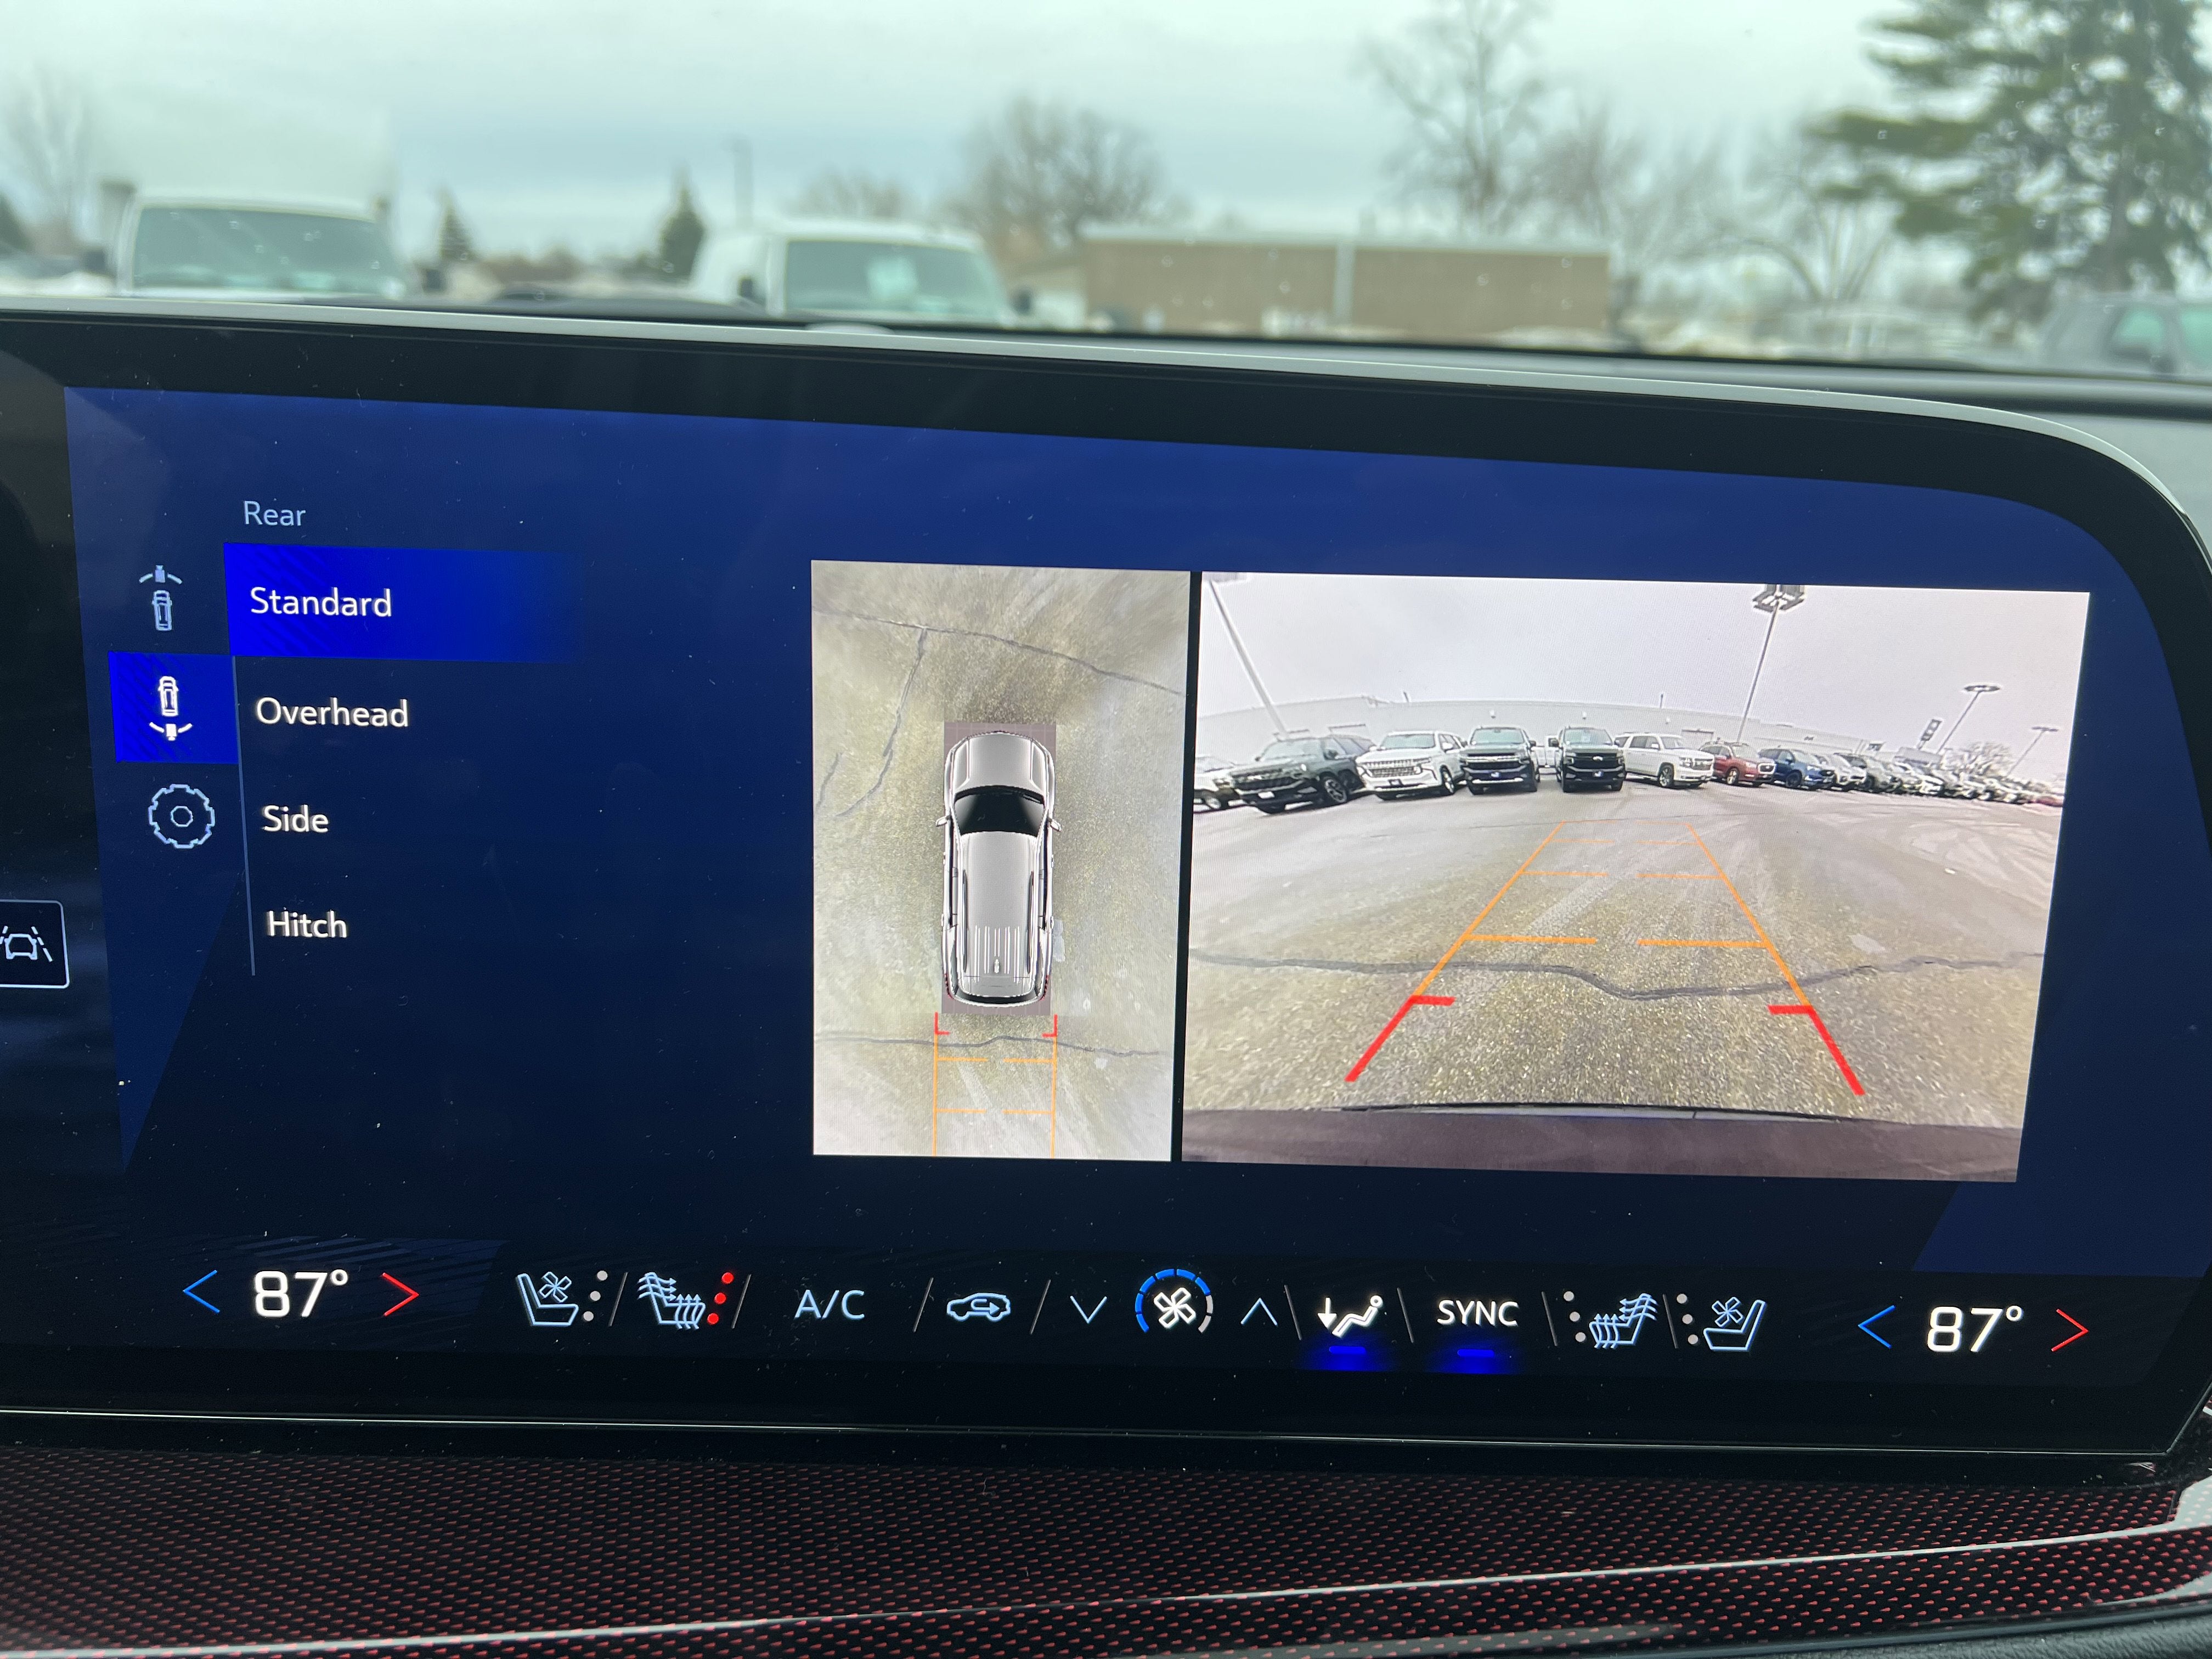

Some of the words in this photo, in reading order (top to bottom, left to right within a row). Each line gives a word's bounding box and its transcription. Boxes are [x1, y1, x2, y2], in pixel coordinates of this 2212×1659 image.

[242, 500, 307, 527] Rear
[250, 586, 393, 618] Standard
[255, 697, 409, 728] Overhead
[262, 804, 330, 833] Side
[266, 909, 348, 939] Hitch
[794, 1288, 865, 1321] A/C
[1436, 1299, 1519, 1328] SYNC
